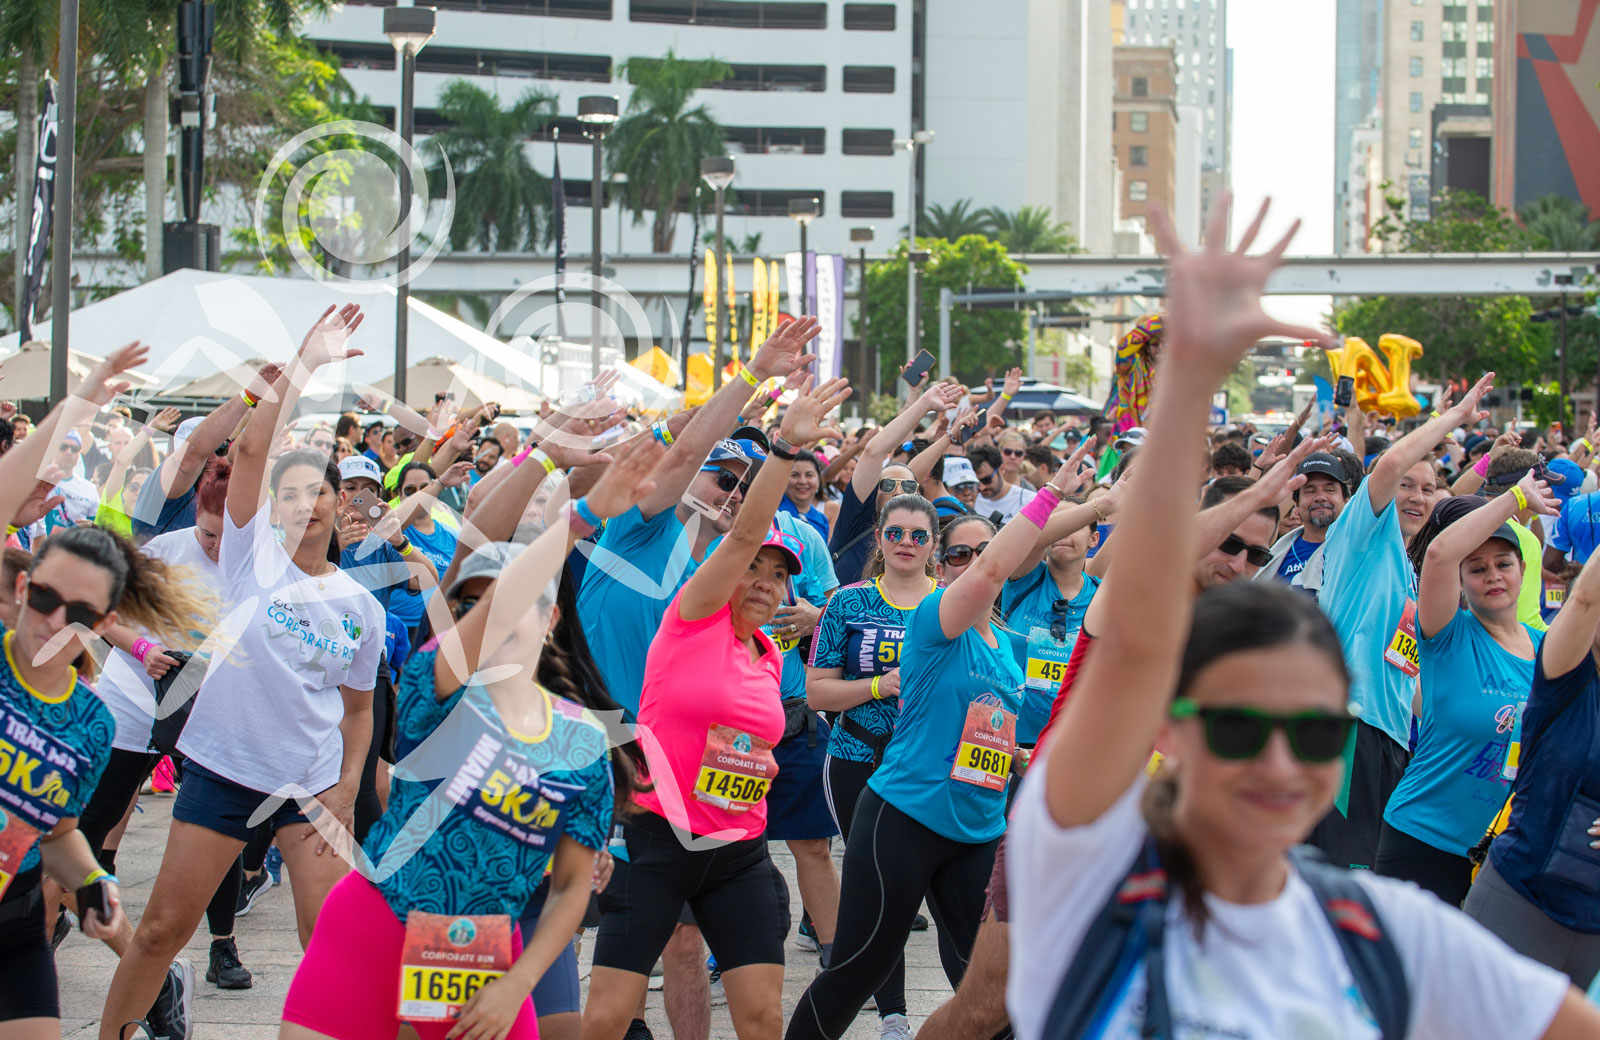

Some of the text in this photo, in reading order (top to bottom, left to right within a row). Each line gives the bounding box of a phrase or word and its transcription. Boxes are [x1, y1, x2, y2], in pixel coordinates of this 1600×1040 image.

[267, 606, 338, 654] CORPORATE
[859, 628, 877, 672] MIAMI
[1038, 648, 1068, 659] CORPORATE
[1041, 662, 1068, 681] 45
[974, 731, 1003, 745] CORPORATE
[445, 732, 503, 806] MIAMI
[717, 755, 767, 772] CORPORATE RUN
[968, 746, 1007, 776] 9681
[481, 769, 533, 822] 5K
[705, 771, 766, 802] 14506
[421, 950, 495, 964] CORPORATE RUN
[413, 970, 499, 1001] 1656
